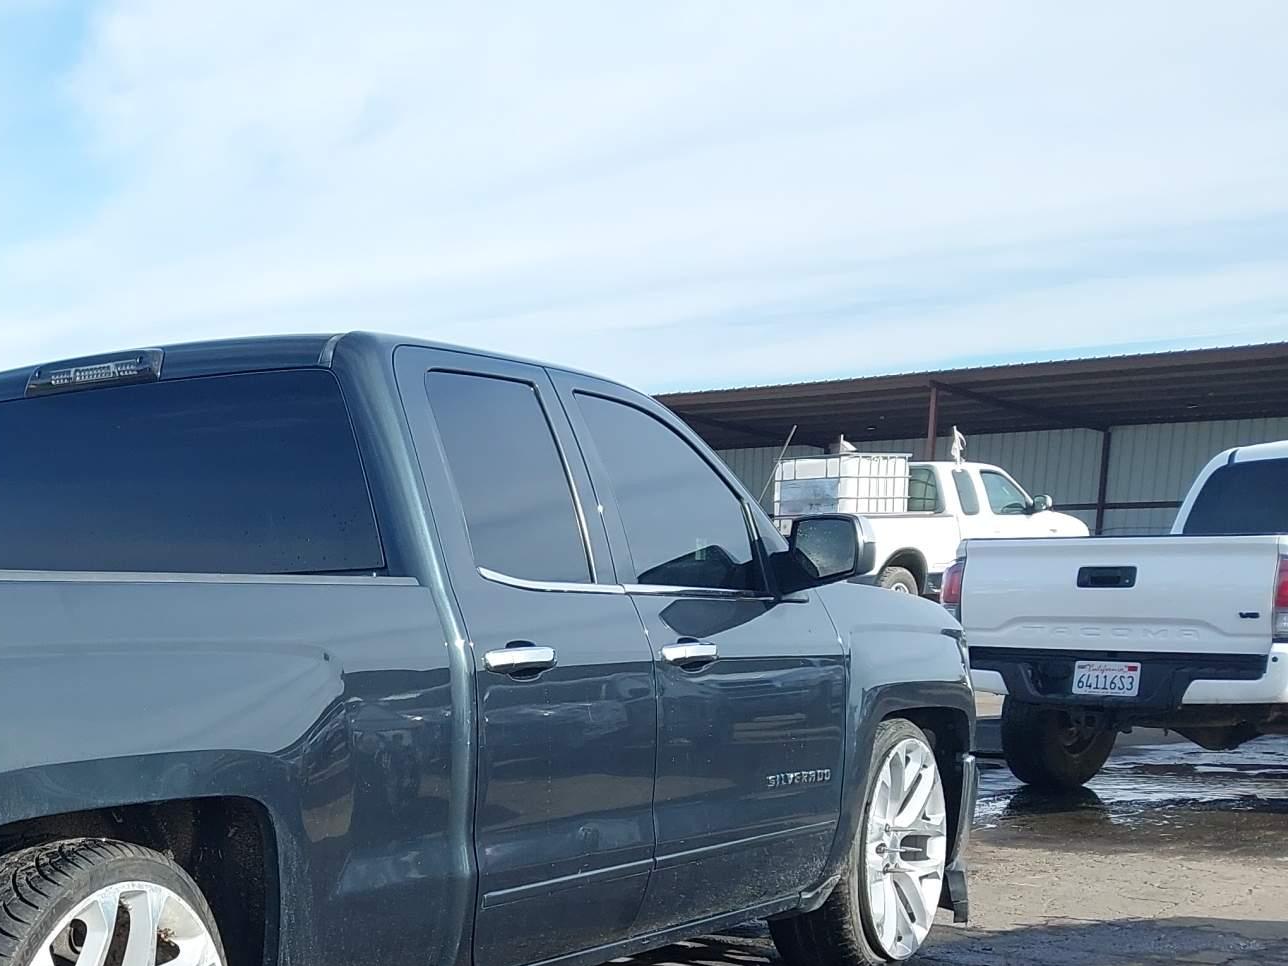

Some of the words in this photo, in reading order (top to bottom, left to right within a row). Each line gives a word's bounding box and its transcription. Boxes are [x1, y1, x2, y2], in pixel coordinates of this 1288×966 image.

[1021, 625, 1201, 641] TACOMA
[1076, 673, 1135, 691] 64116S3
[767, 769, 831, 787] SILVERADO
